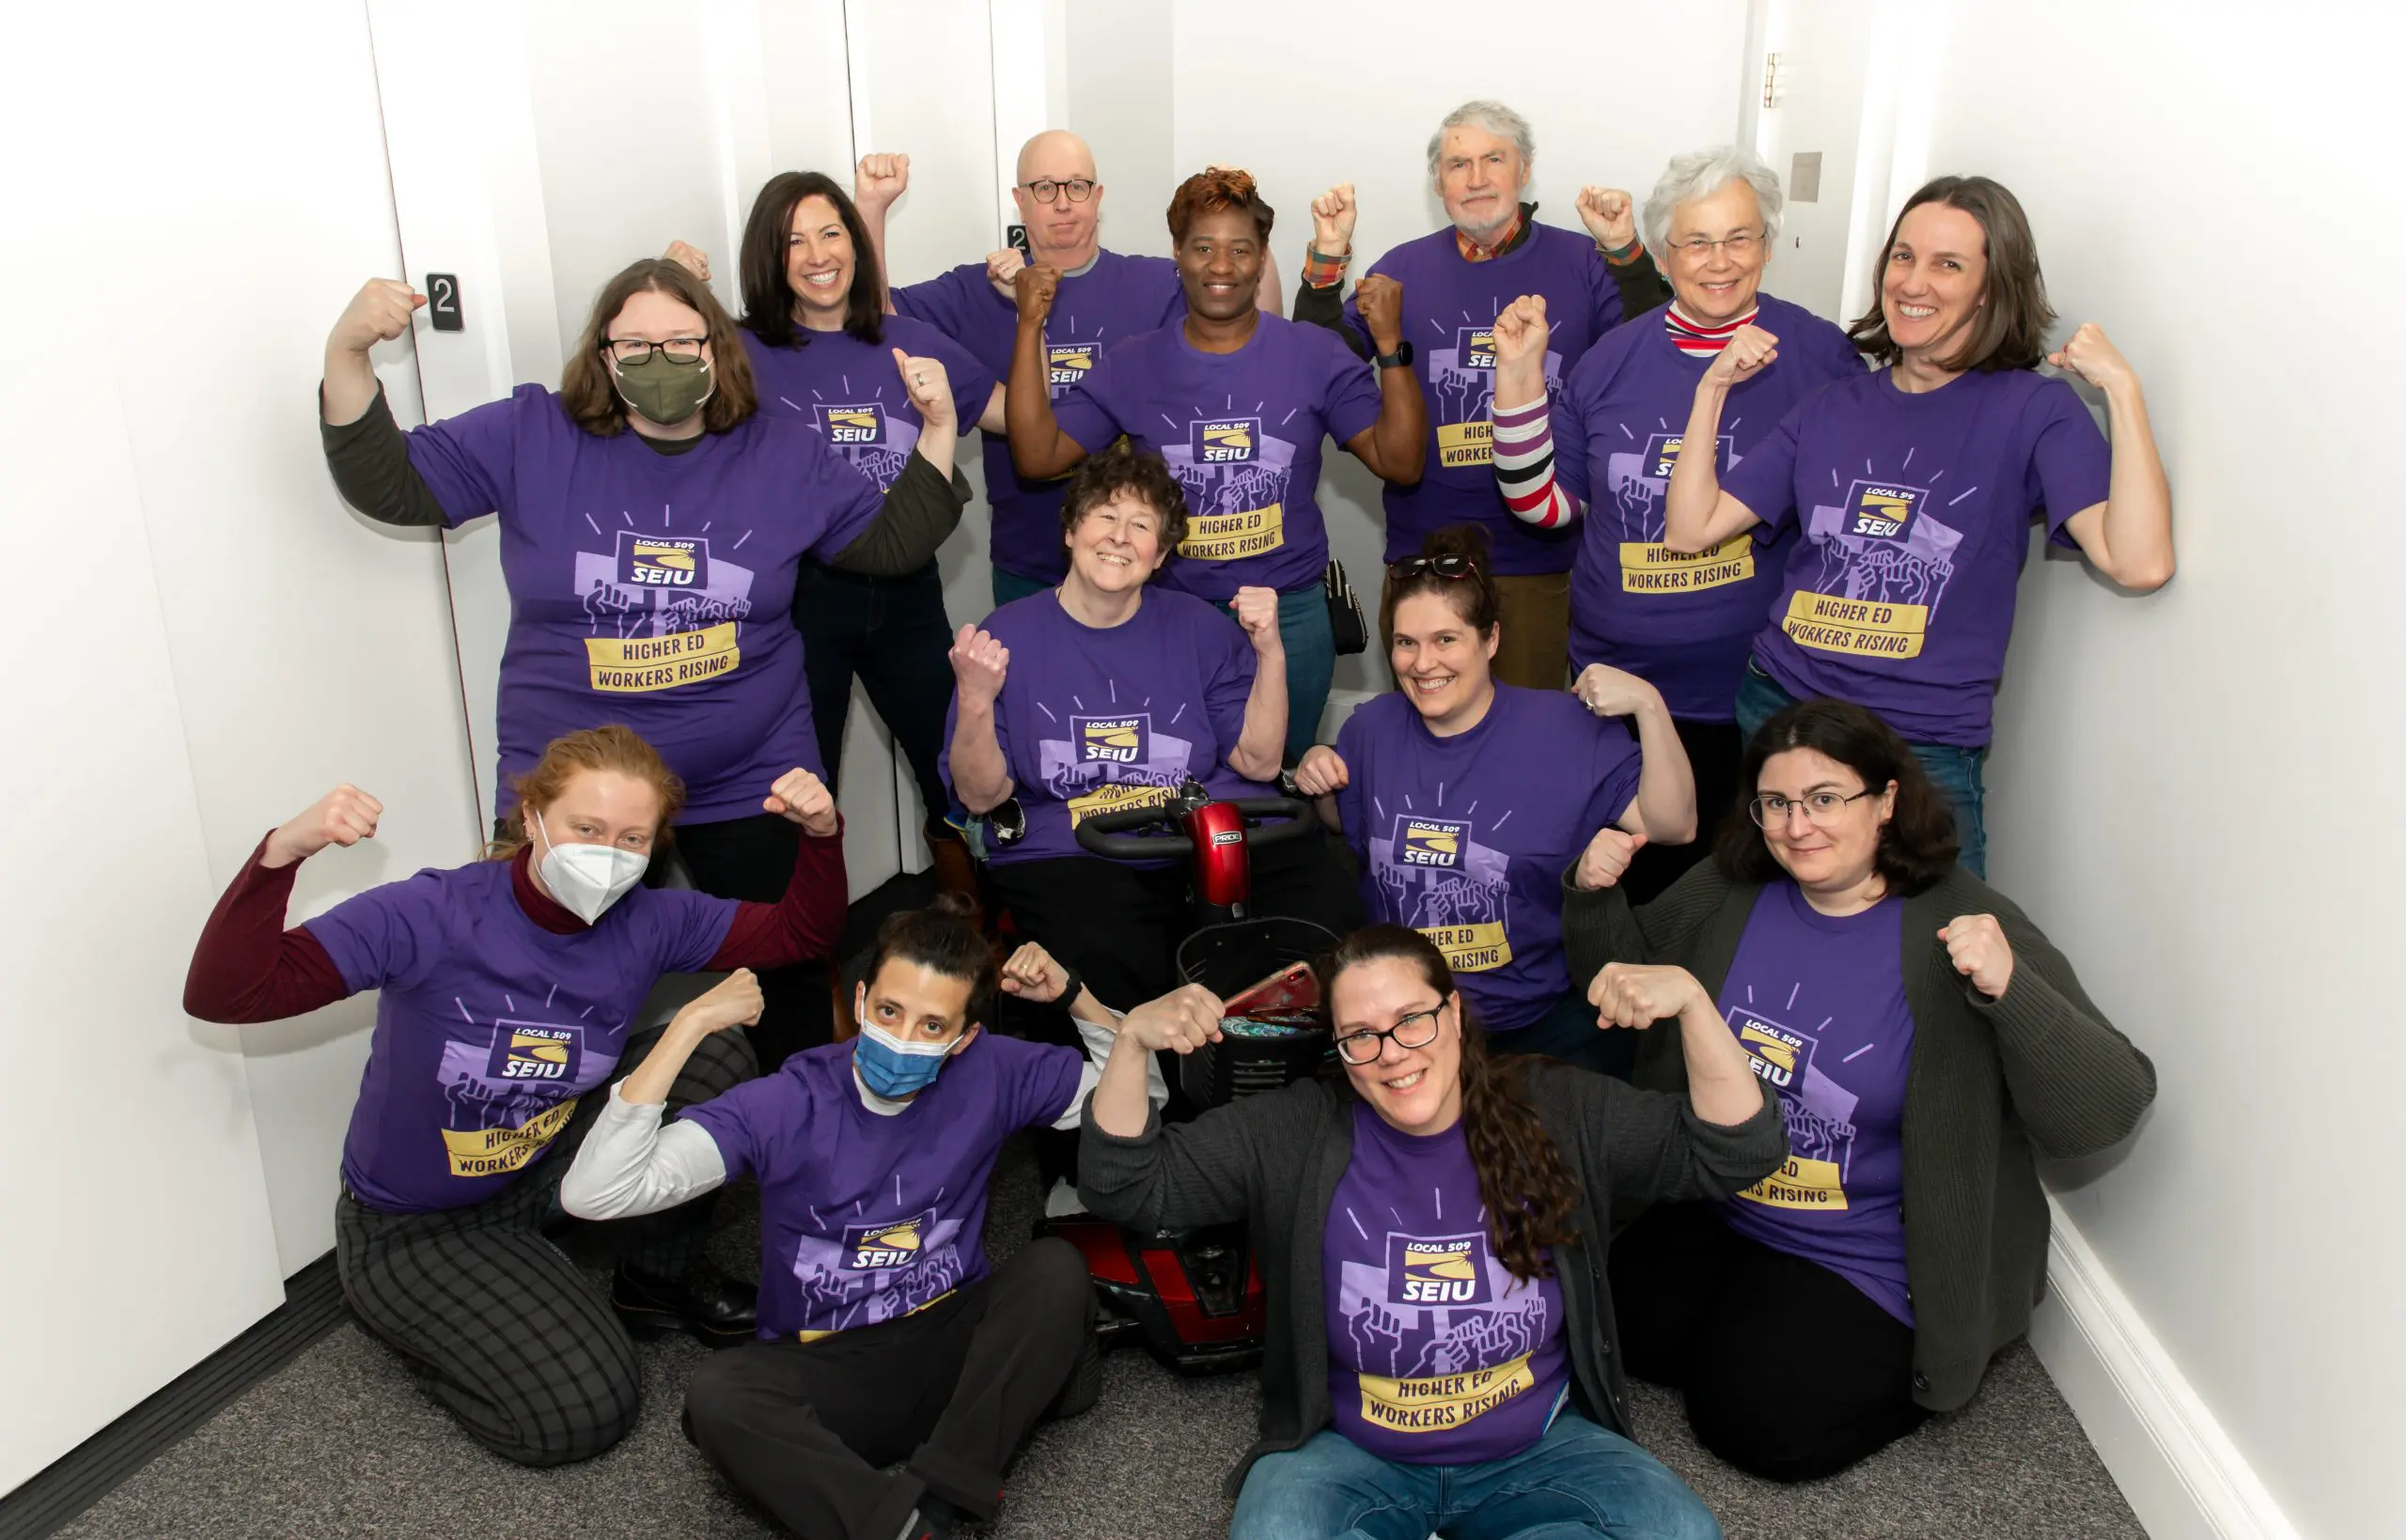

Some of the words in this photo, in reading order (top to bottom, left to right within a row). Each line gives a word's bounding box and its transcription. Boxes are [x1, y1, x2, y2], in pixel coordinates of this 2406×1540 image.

[1012, 227, 1026, 251] 2
[434, 278, 455, 313] 2
[1468, 354, 1497, 367] SEI
[1051, 370, 1084, 382] SEI
[832, 428, 877, 442] SEIU
[1464, 425, 1492, 440] HIGH
[1203, 448, 1251, 461] SEIU
[1446, 446, 1492, 463] WORKER
[1865, 487, 1898, 498] LOCAL
[1199, 518, 1243, 535] HIGHER
[1247, 514, 1261, 529] ED
[1852, 518, 1902, 537] SEIU
[634, 538, 672, 548] LOCAL
[673, 541, 695, 550] 509
[1182, 541, 1235, 557] WORKERS
[1239, 531, 1275, 552] RISING
[631, 568, 695, 584] SEIU
[1628, 572, 1688, 589] WORKERS
[1694, 562, 1742, 586] RISING
[1814, 599, 1867, 622] HIGHER
[1871, 607, 1893, 624] ED
[1788, 620, 1852, 647] WORKERS
[1853, 633, 1909, 653] RISING
[623, 636, 682, 661] HIGHER
[687, 633, 705, 651] ED
[599, 667, 674, 687] WORKERS
[679, 655, 729, 680] RISING
[1086, 746, 1139, 762] SEIU
[1409, 820, 1441, 832] LOCAL
[1403, 849, 1457, 866] SEIU
[1458, 928, 1474, 944] ED
[1452, 949, 1499, 969] RISING
[514, 1028, 550, 1038] LOCAL
[552, 1032, 572, 1040] 509
[1745, 1019, 1779, 1039] LOCAL
[1781, 1033, 1804, 1048] 509
[501, 1060, 567, 1079] SEIU
[1745, 1053, 1793, 1087] EIU
[543, 1109, 560, 1128] ED
[459, 1143, 531, 1174] WORKERS
[1769, 1184, 1828, 1203] RISING
[1407, 1242, 1445, 1252] LOCAL
[1446, 1241, 1472, 1251] 509
[852, 1250, 918, 1268] SEIU
[1402, 1281, 1476, 1301] SEIU
[1398, 1376, 1465, 1398] HIGHER
[1472, 1370, 1493, 1388] ED
[1370, 1400, 1456, 1427] WORKERS
[1462, 1377, 1521, 1419] RISING
